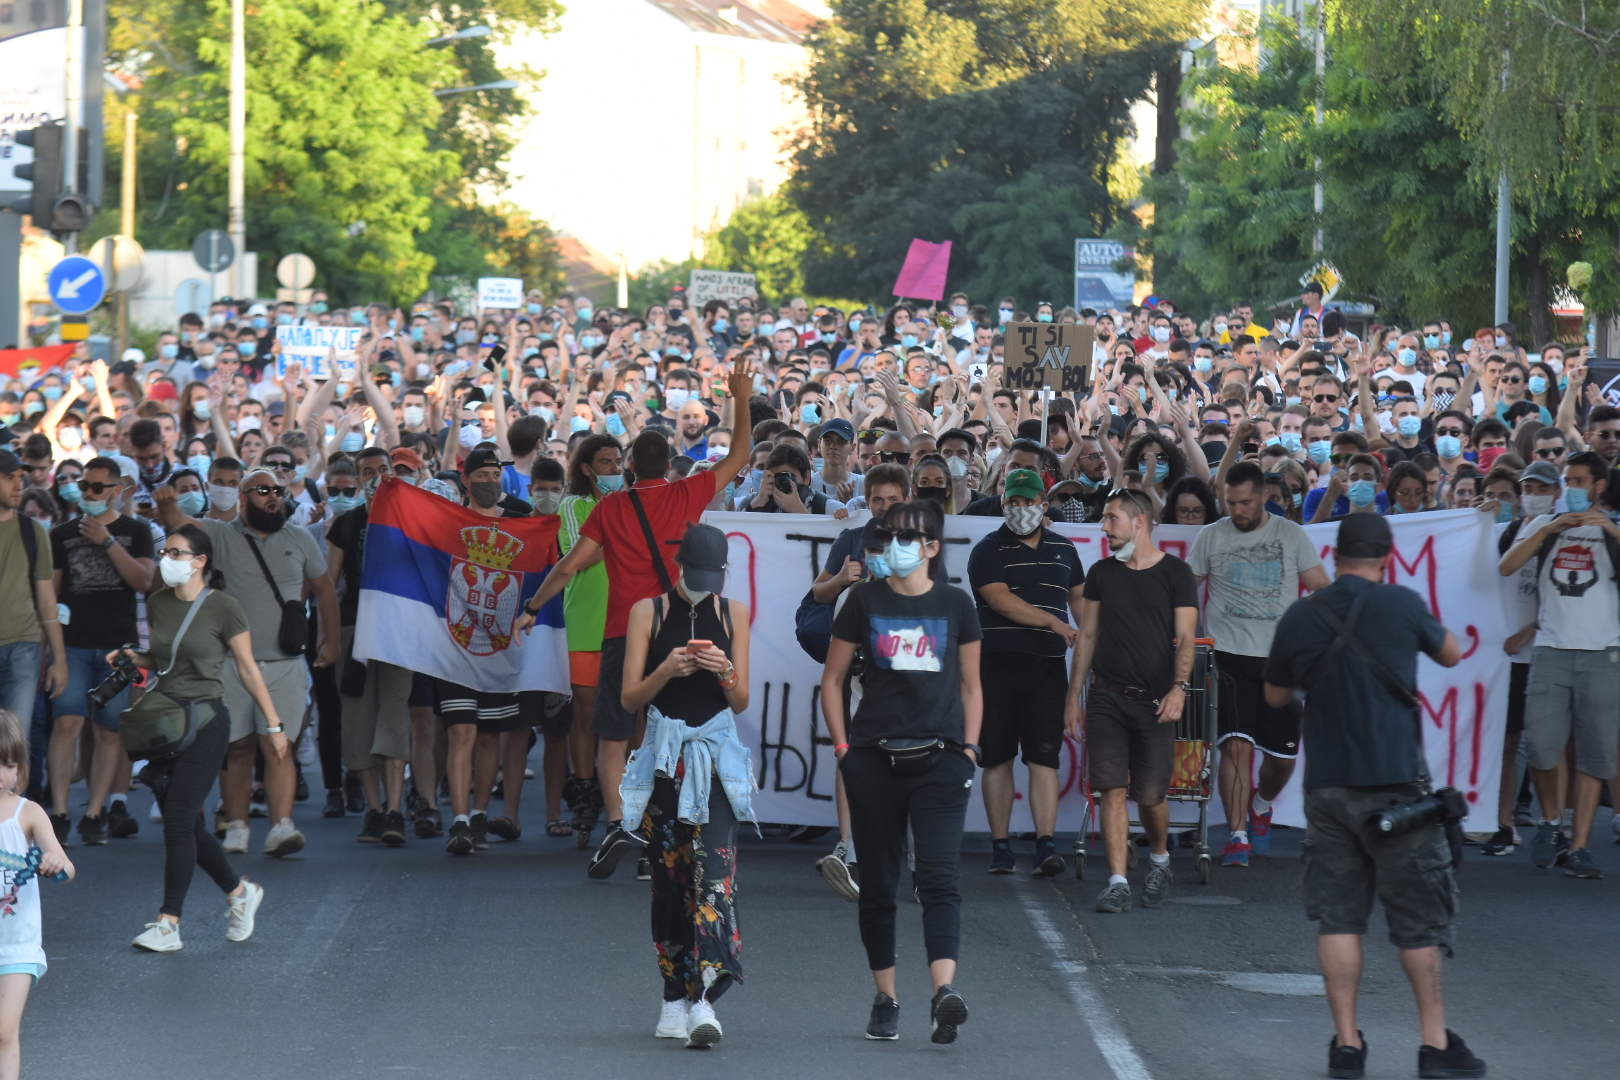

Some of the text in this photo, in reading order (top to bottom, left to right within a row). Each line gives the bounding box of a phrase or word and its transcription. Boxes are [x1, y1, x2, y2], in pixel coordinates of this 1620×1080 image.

[1080, 243, 1124, 257] AUTO
[1080, 256, 1121, 265] SYSTE
[716, 286, 747, 295] LITTLE
[1018, 325, 1064, 346] TI SI
[1006, 365, 1089, 392] MOJ BOL
